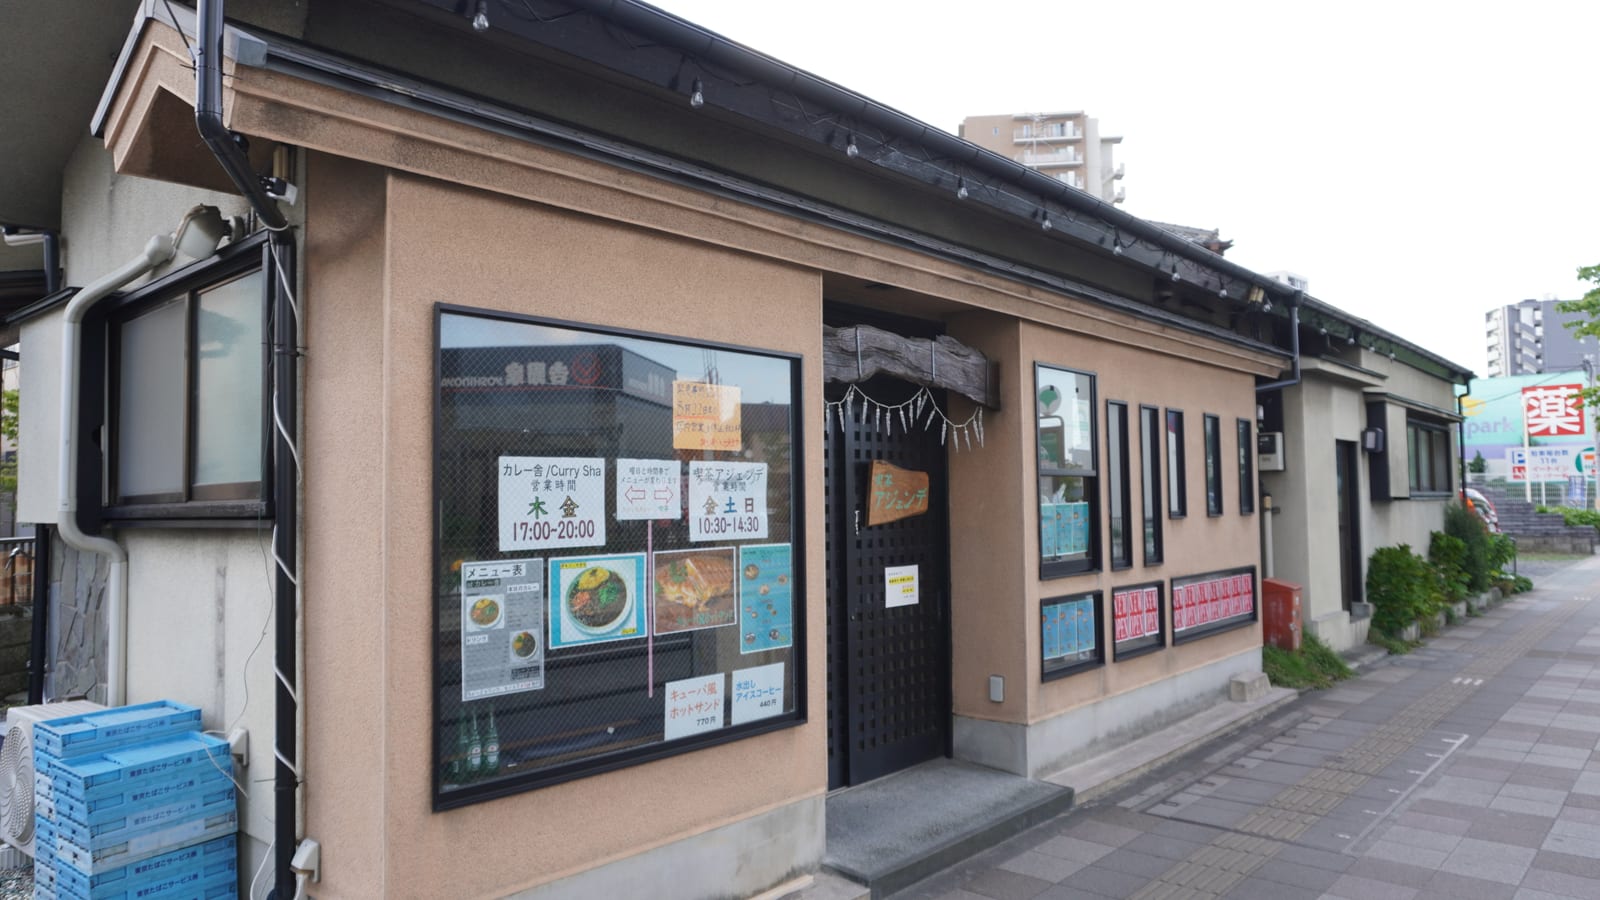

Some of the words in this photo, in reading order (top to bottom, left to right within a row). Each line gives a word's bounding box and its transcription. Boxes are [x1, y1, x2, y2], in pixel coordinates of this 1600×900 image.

[1524, 387, 1581, 435] 薬
[582, 465, 601, 477] Sha
[531, 479, 576, 492] 営業時間
[713, 481, 746, 492] 営業時間
[527, 496, 549, 520] 木
[559, 495, 579, 518] 金
[702, 496, 718, 515] 金
[723, 496, 737, 513] 土
[744, 497, 754, 513] 日
[873, 487, 928, 511] アジェンデ
[467, 564, 523, 579] メニュー表
[670, 681, 718, 702] キューバ風
[735, 680, 756, 691] 水出し
[735, 686, 782, 703] アイスコーヒー
[669, 698, 720, 719] ホットサンド
[696, 716, 716, 726] 770円
